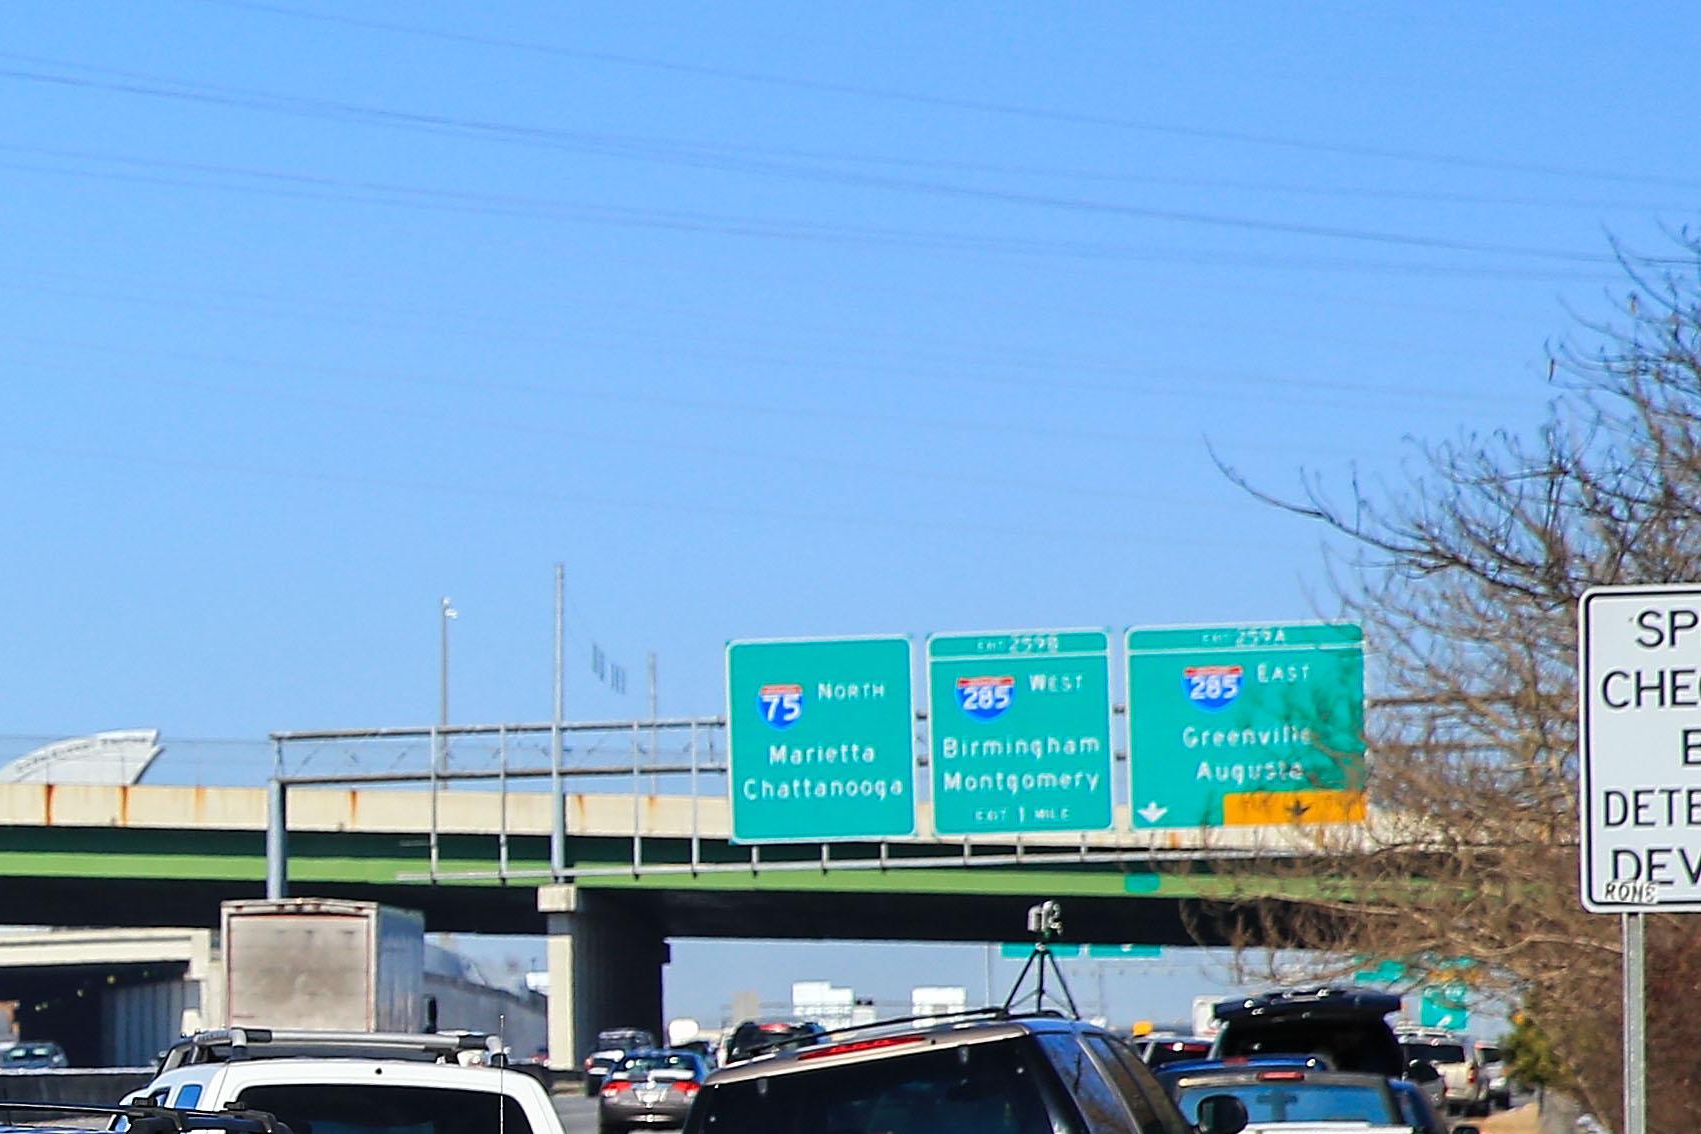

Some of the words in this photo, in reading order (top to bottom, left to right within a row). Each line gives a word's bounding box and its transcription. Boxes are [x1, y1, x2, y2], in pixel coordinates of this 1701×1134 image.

[963, 686, 1011, 710] 285
[1029, 674, 1083, 692] WEST
[1190, 675, 1238, 700] 285
[1257, 664, 1310, 683] EAST
[762, 694, 802, 722] 75
[818, 682, 885, 700] NORTH
[943, 736, 1100, 760] Birmingham
[1182, 726, 1314, 749] Greenville
[769, 744, 875, 765] Marietta
[944, 771, 1100, 795] Montgomery
[1197, 760, 1305, 785] Augusta
[744, 778, 903, 801] Chattanooga
[1018, 807, 1025, 823] 1
